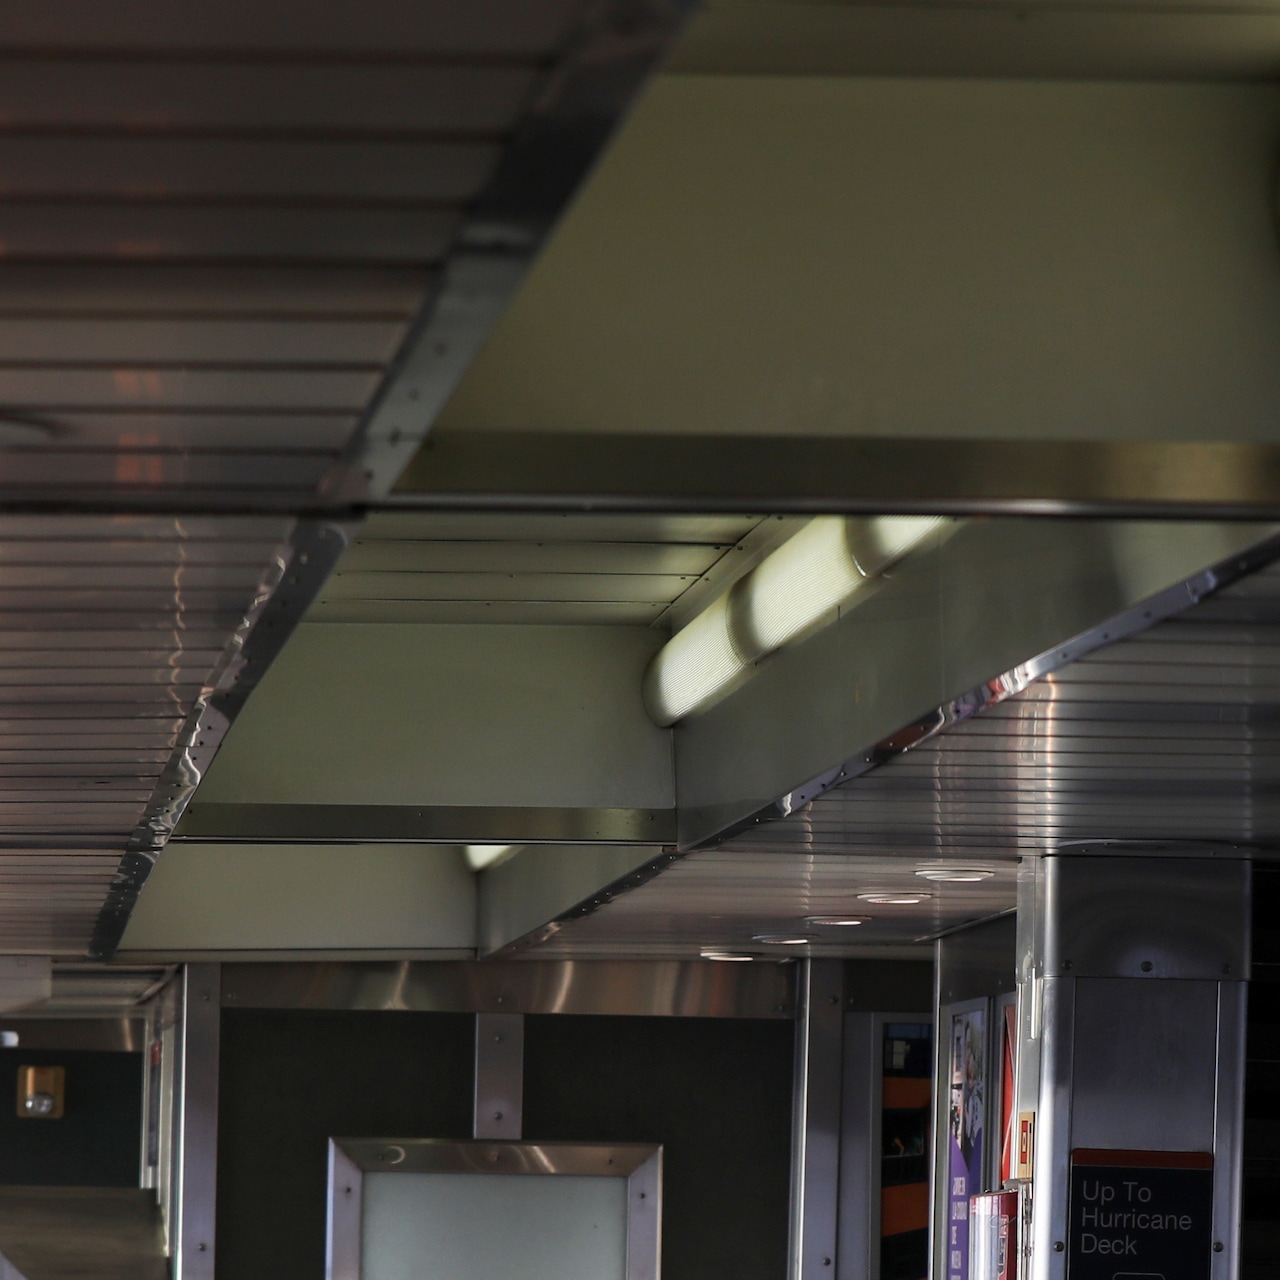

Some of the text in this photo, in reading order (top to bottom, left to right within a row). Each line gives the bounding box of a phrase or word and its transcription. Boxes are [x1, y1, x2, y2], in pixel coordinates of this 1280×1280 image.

[1082, 1180, 1152, 1207] Up To
[1081, 1206, 1193, 1231] Hurricane
[1081, 1233, 1138, 1256] Deck
